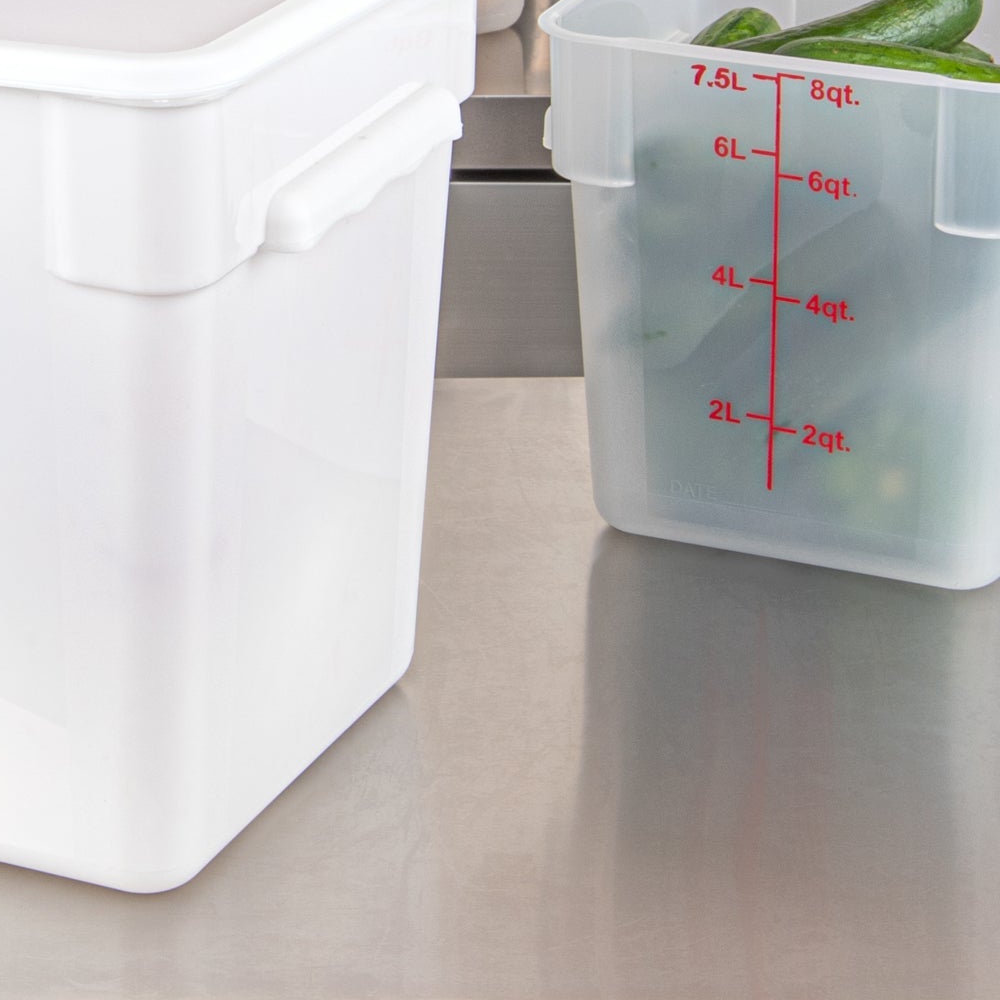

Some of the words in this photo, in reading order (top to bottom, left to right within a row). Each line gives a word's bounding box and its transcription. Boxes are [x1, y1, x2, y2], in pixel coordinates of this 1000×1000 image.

[691, 64, 747, 91] 7.5L
[810, 79, 860, 108] 8qt.
[713, 136, 747, 160] 6L
[807, 170, 857, 200] 6qt.
[711, 265, 744, 289] 4L
[805, 294, 855, 323] 4qt.
[708, 399, 741, 424] 2L
[802, 424, 851, 453] 2qt.
[670, 479, 720, 500] DATE
